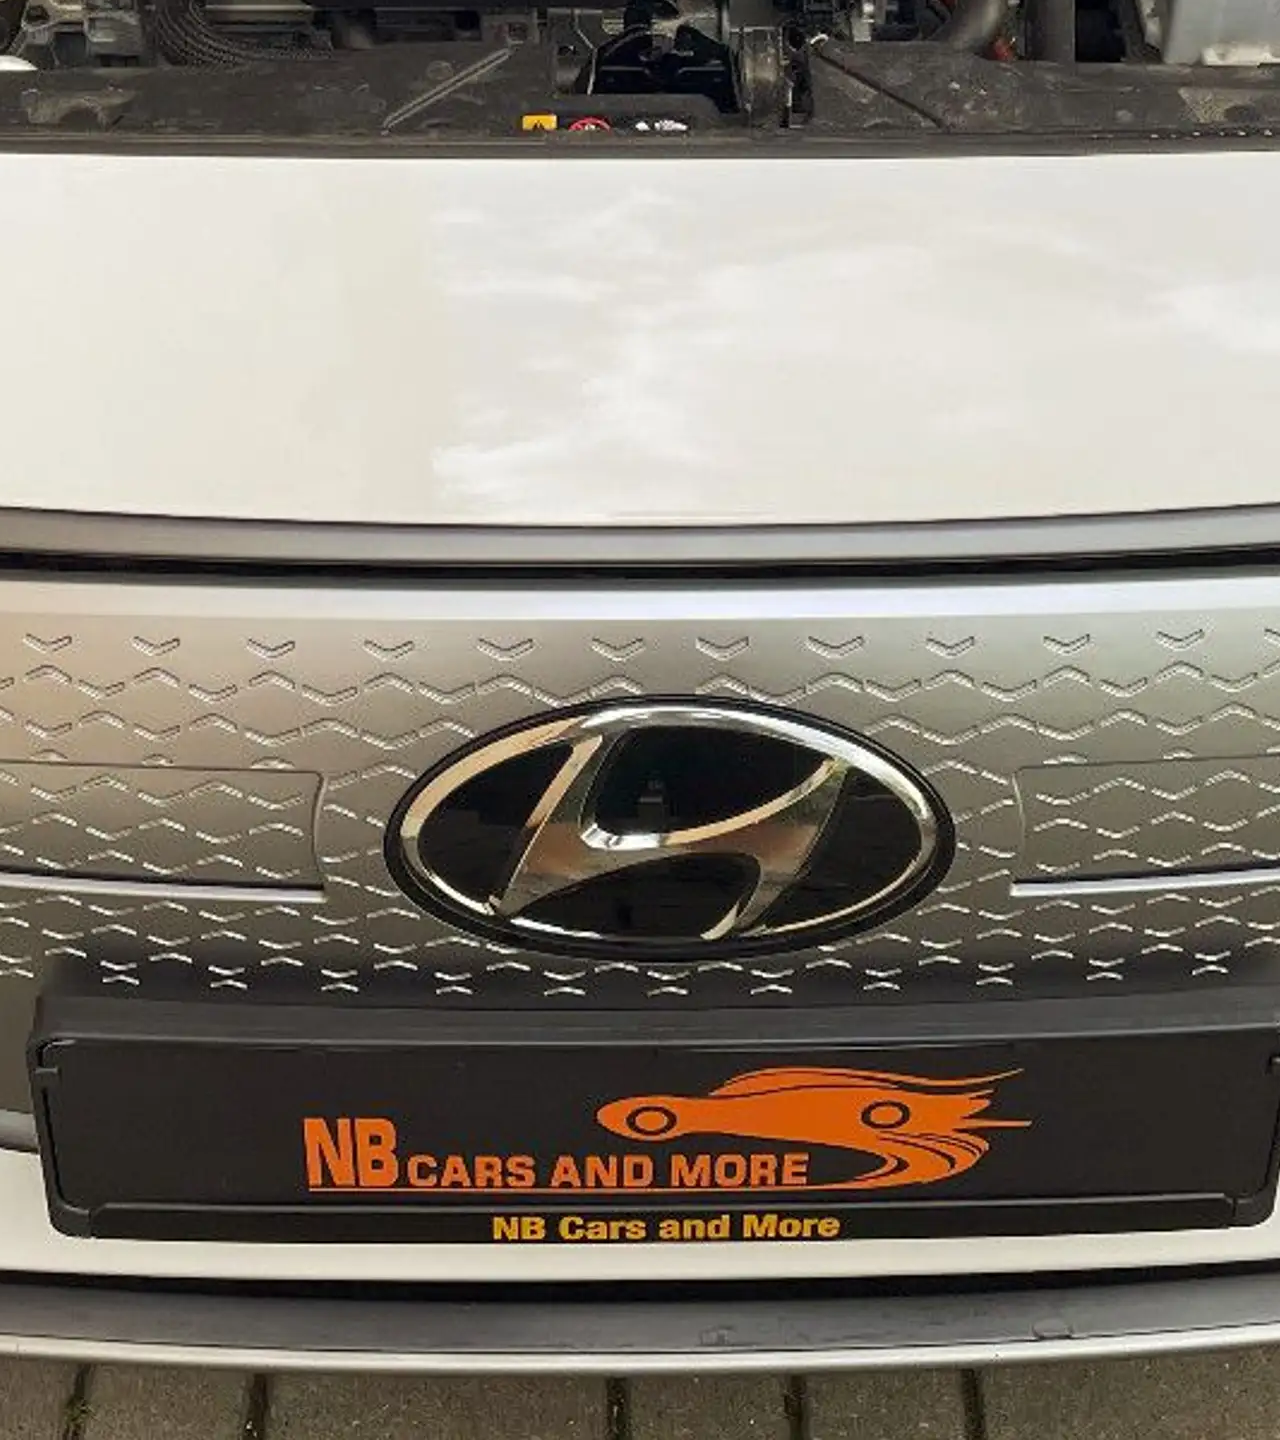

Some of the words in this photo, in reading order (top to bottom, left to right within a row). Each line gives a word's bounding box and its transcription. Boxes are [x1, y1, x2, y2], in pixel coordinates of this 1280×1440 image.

[302, 1117, 398, 1188] NB
[407, 1153, 536, 1188] CARS
[549, 1153, 654, 1187] AND
[670, 1152, 810, 1187] MORE
[491, 1216, 546, 1241] NB
[558, 1215, 646, 1241] Cars
[658, 1214, 737, 1240] and
[742, 1214, 842, 1239] More
